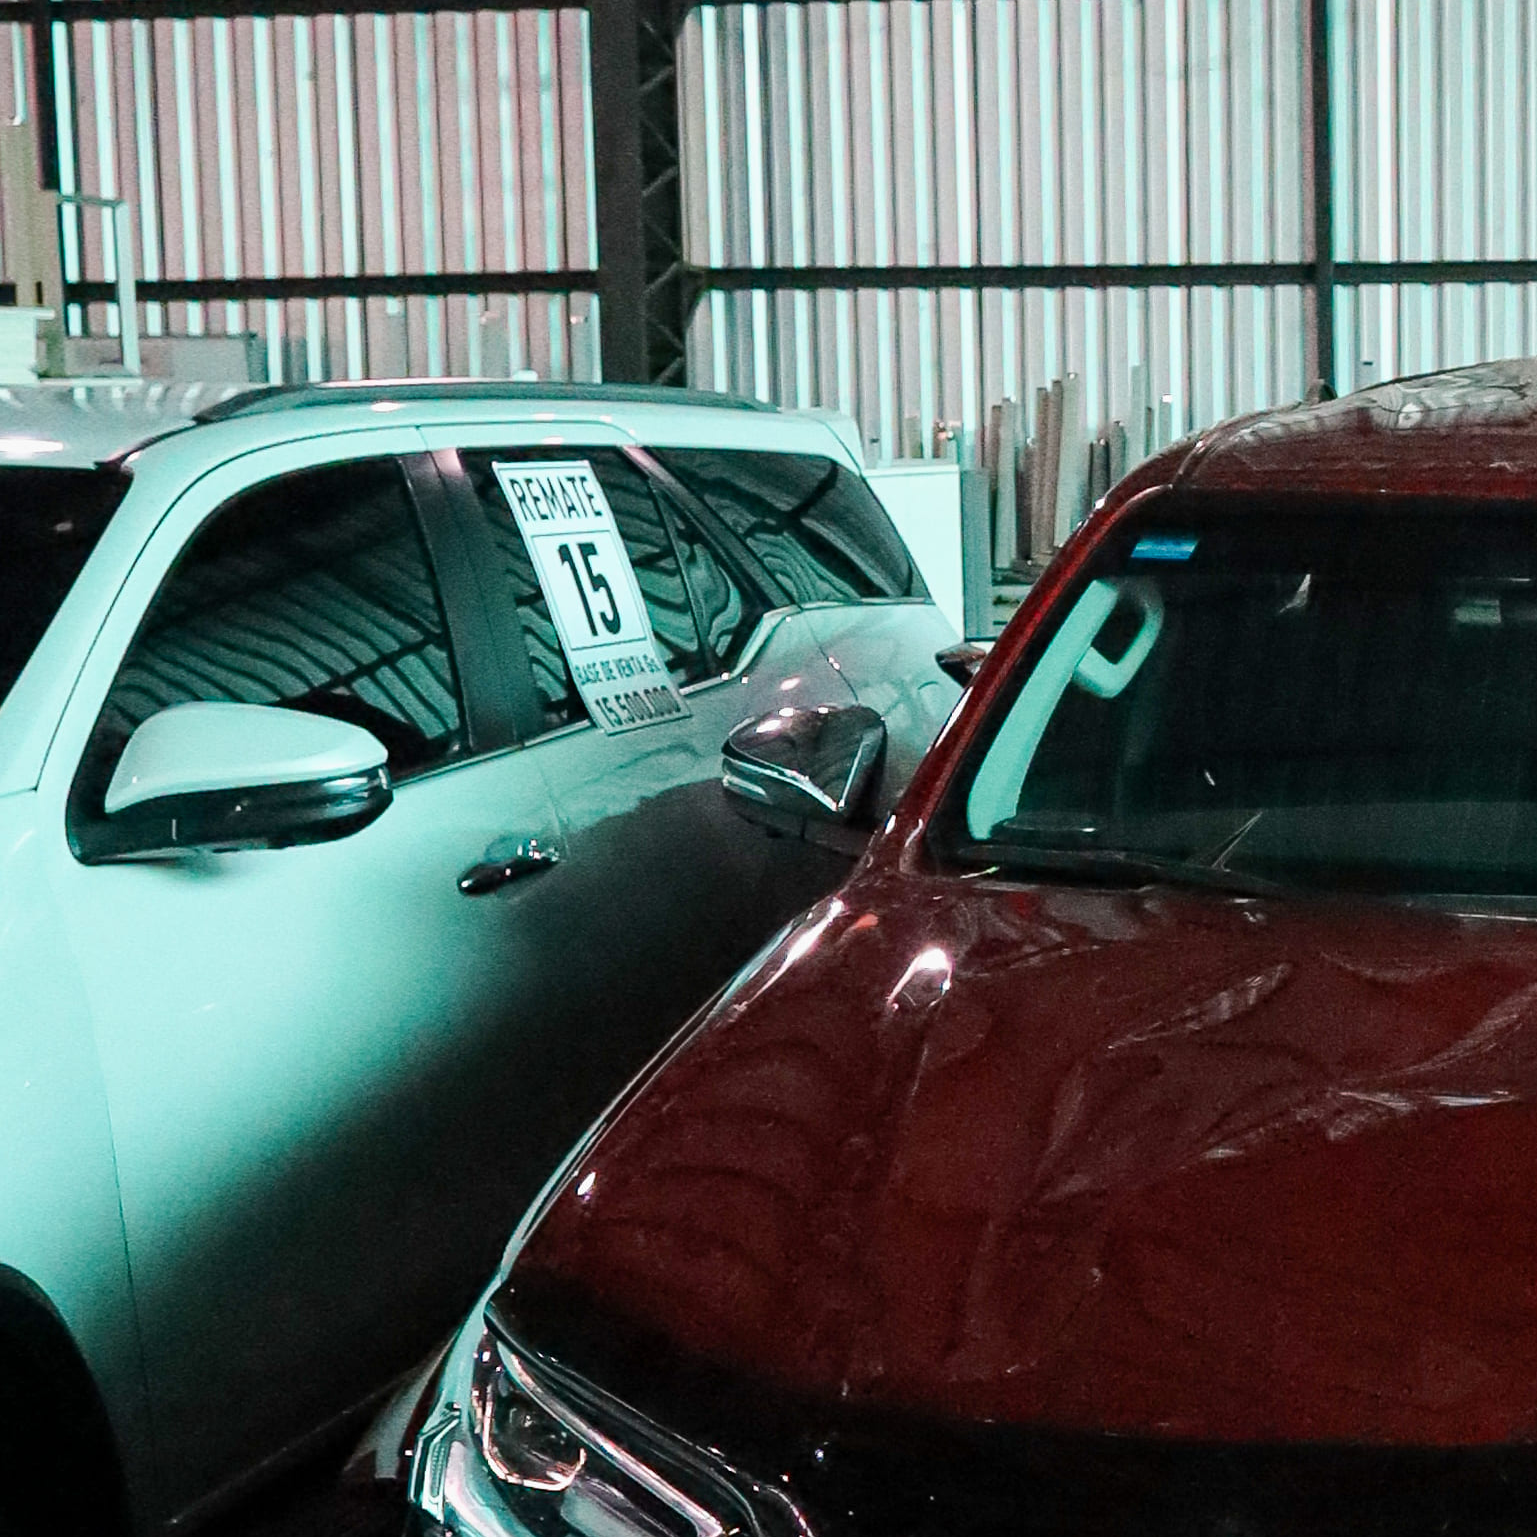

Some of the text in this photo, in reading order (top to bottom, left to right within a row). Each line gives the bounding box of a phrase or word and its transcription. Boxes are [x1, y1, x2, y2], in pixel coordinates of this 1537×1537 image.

[509, 476, 602, 521] REMATE
[558, 542, 621, 636] 15
[575, 662, 603, 685] BASE
[600, 660, 617, 681] DE
[613, 656, 646, 679] VENTA
[594, 685, 681, 728] 15.500.000
